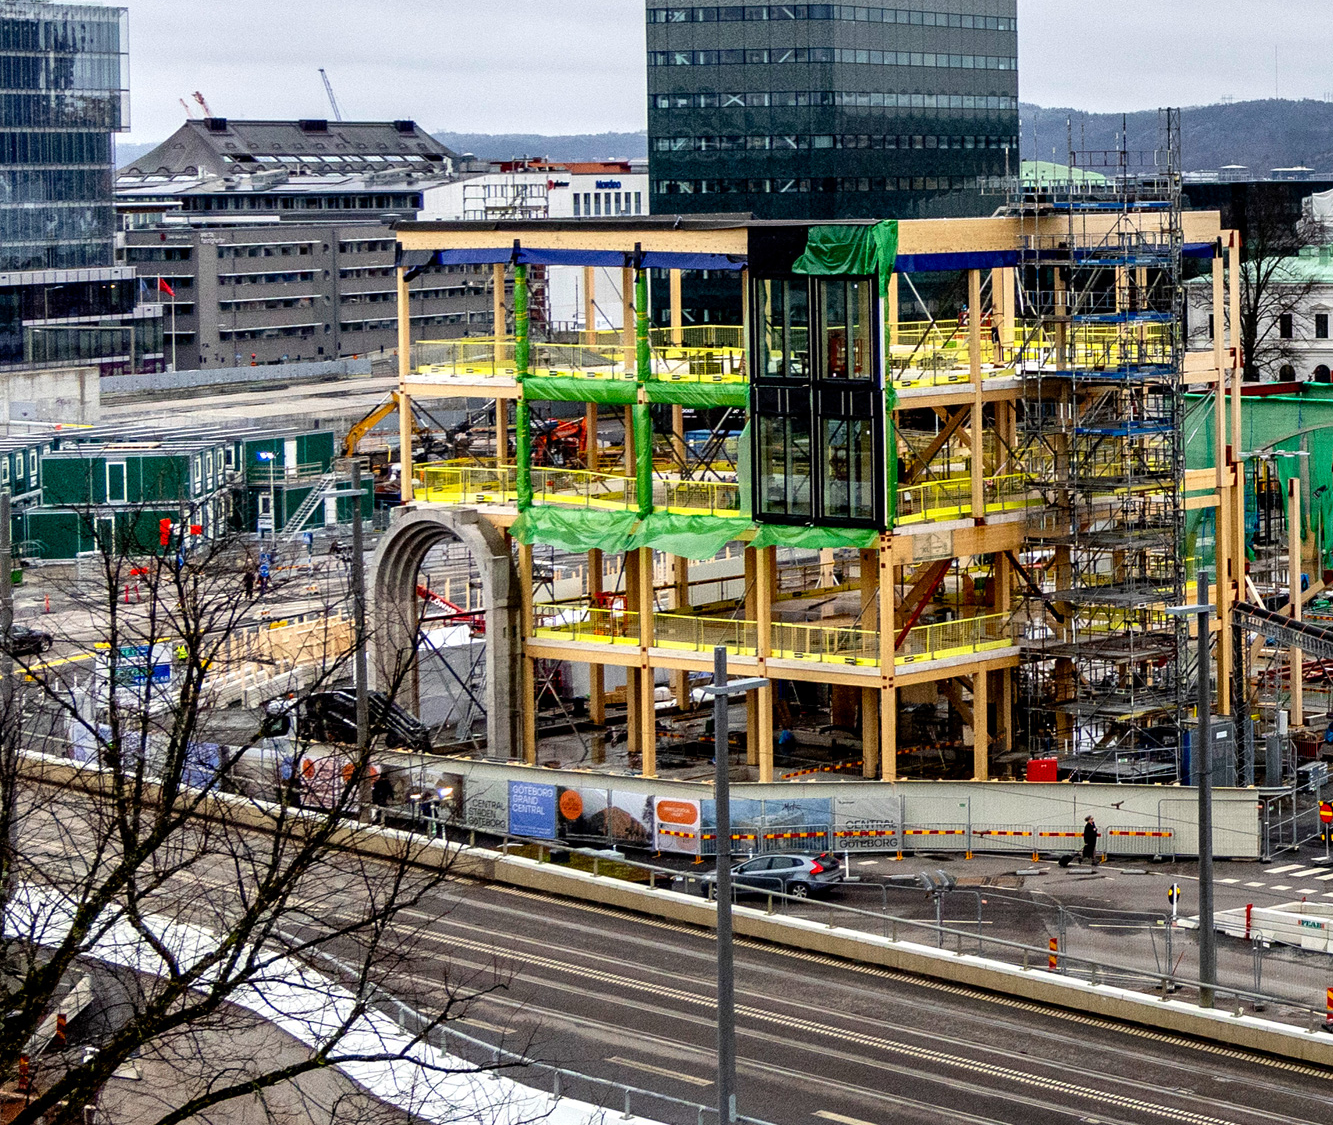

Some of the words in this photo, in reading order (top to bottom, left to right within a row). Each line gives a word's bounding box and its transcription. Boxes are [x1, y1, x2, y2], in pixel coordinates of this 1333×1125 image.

[512, 784, 554, 797] GÖTEBORG
[472, 798, 506, 811] CENTRAL
[512, 795, 538, 805] GRAND
[468, 807, 496, 819] STADEN
[512, 804, 545, 815] CENTRAL
[468, 816, 506, 829] GÖTEBORG
[845, 819, 897, 829] CENTRAL
[839, 838, 898, 848] GÖTEBORG
[1301, 920, 1322, 929] PEAB
